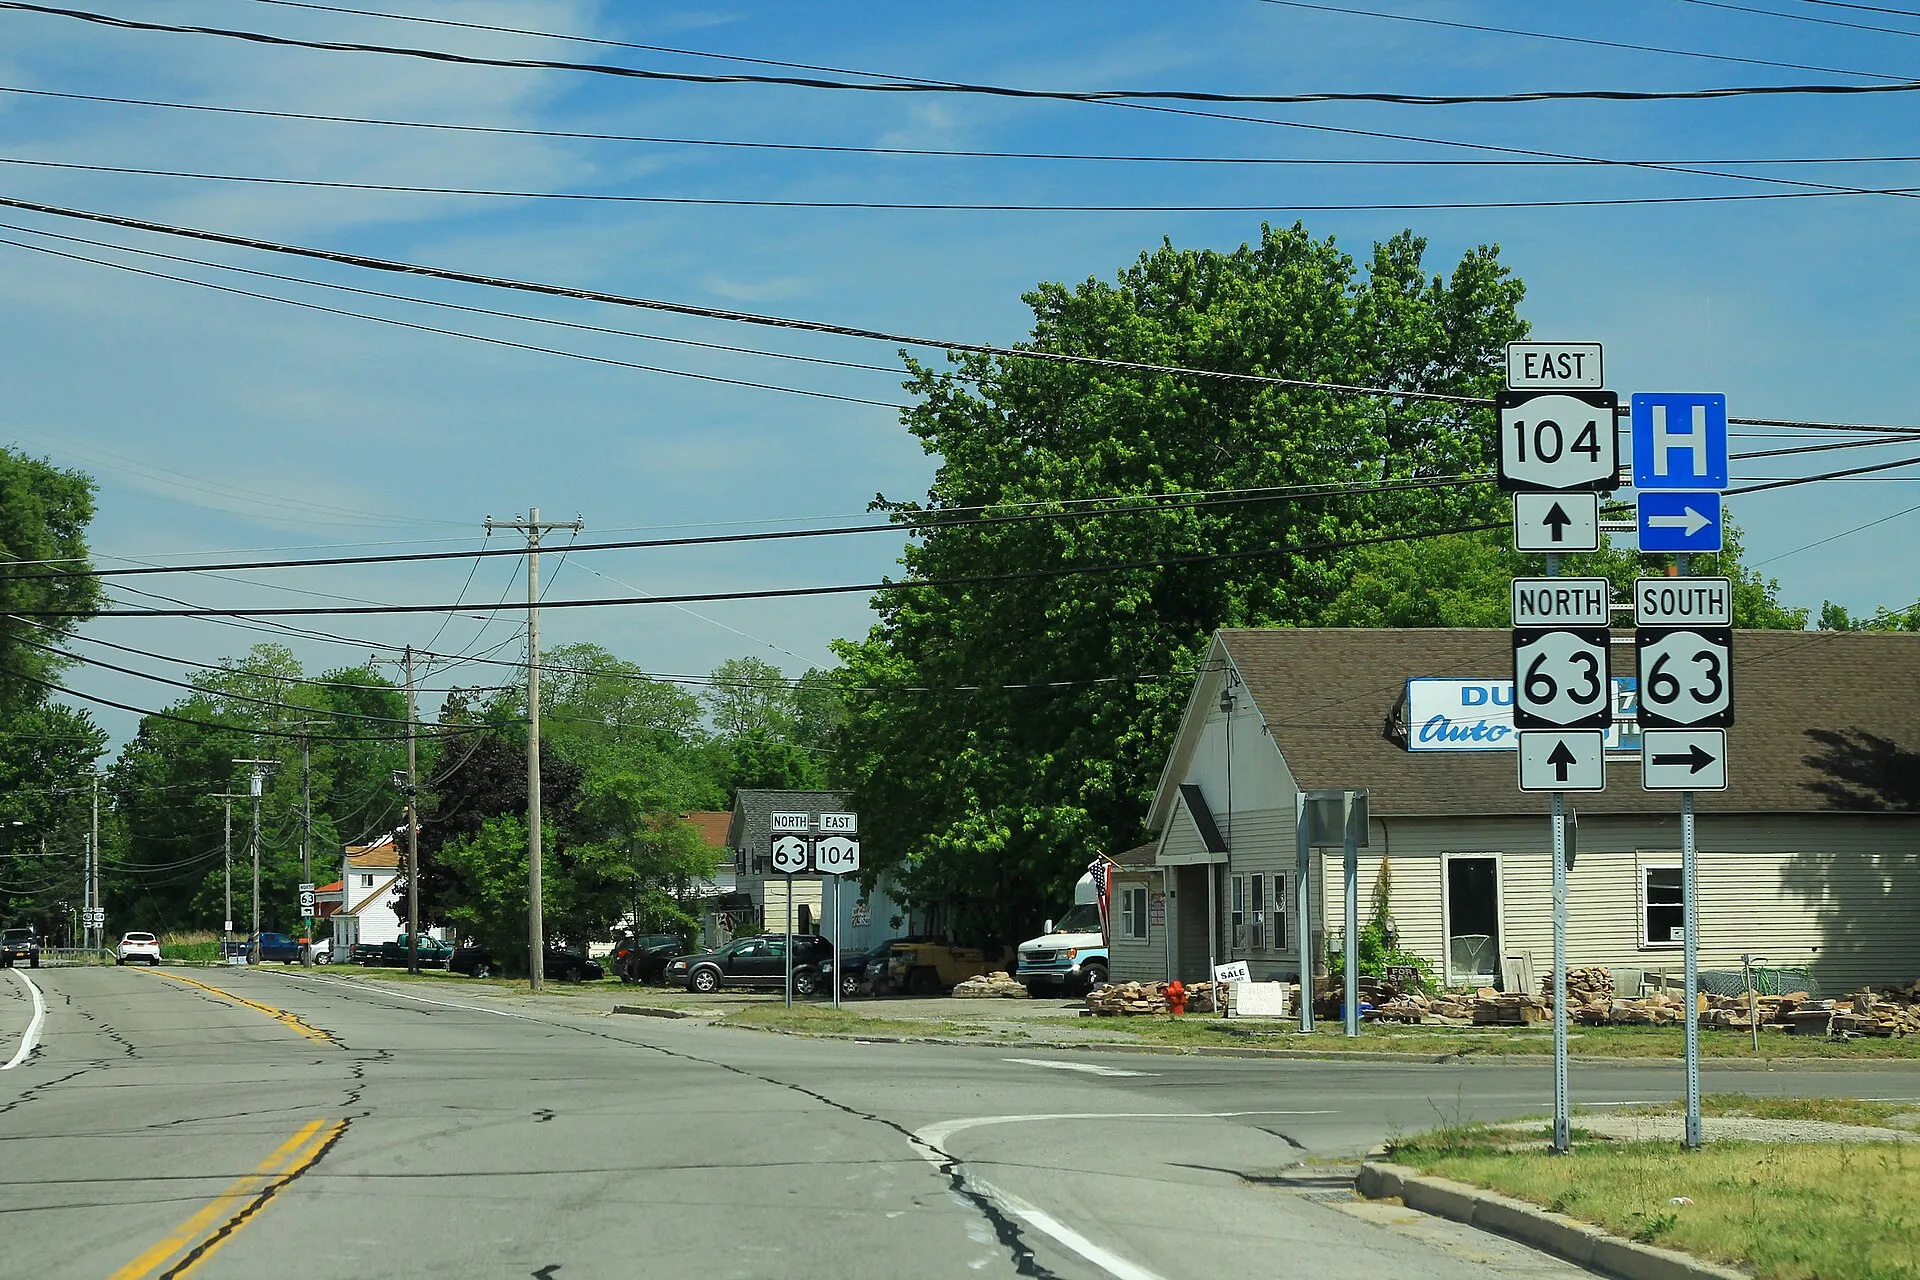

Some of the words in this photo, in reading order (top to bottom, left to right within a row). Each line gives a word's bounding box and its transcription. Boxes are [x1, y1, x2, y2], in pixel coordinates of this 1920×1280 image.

[1524, 353, 1586, 380] EAST
[1513, 420, 1602, 464] 104
[1652, 405, 1708, 476] H
[1520, 589, 1602, 616] NORTH
[1643, 588, 1724, 616] SOUTH
[1524, 651, 1601, 705] 63
[1647, 650, 1723, 705] 63
[1461, 686, 1514, 706] DU
[1418, 715, 1512, 743] Auto
[774, 816, 807, 827] NORTH
[825, 817, 850, 828] EAST
[775, 844, 805, 865] 63
[821, 846, 855, 865] 104
[301, 894, 314, 904] 63
[1220, 968, 1246, 980] SALE
